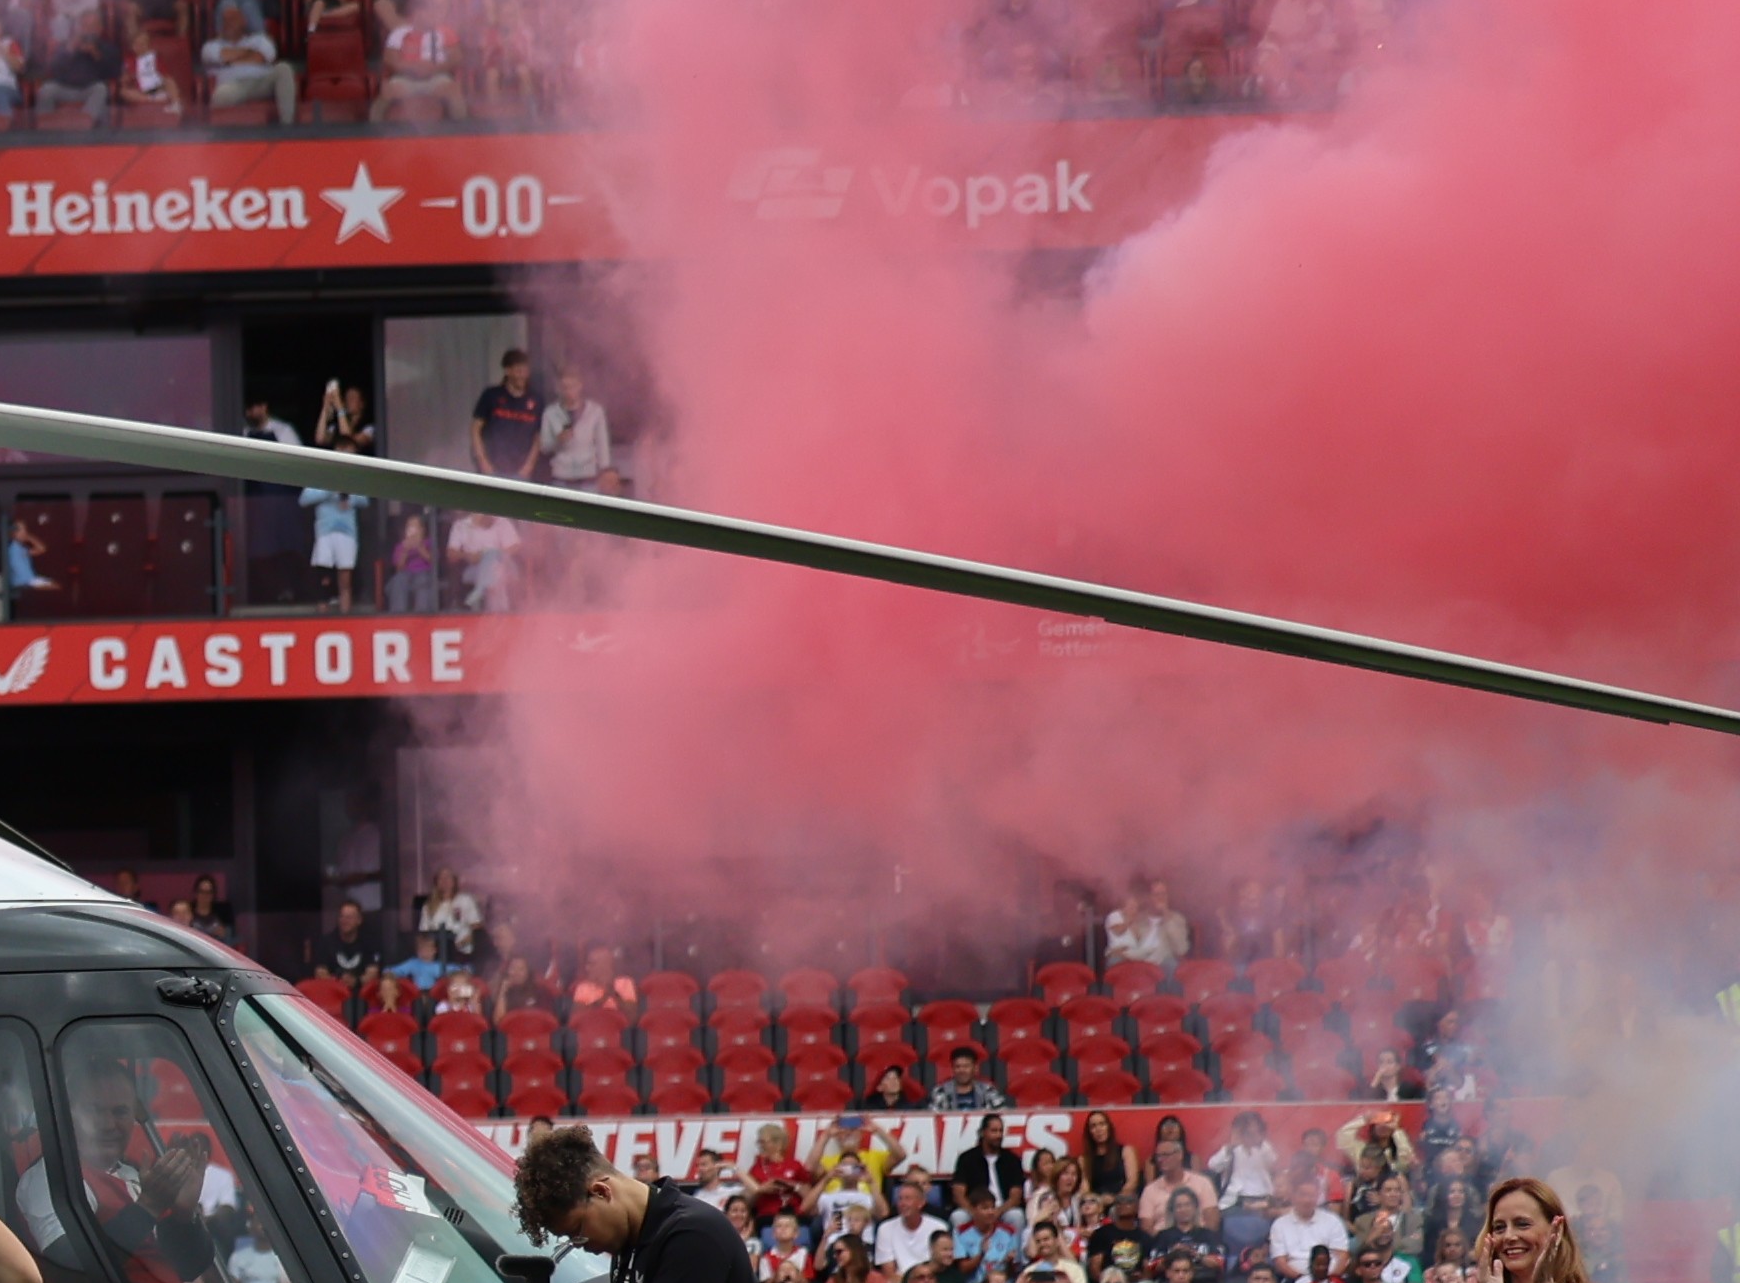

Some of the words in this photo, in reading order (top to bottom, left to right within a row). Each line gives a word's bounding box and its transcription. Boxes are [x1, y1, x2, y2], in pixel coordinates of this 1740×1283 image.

[6, 178, 307, 237] Heineken
[870, 157, 1094, 228] Vopak
[89, 631, 464, 692] CASTORE
